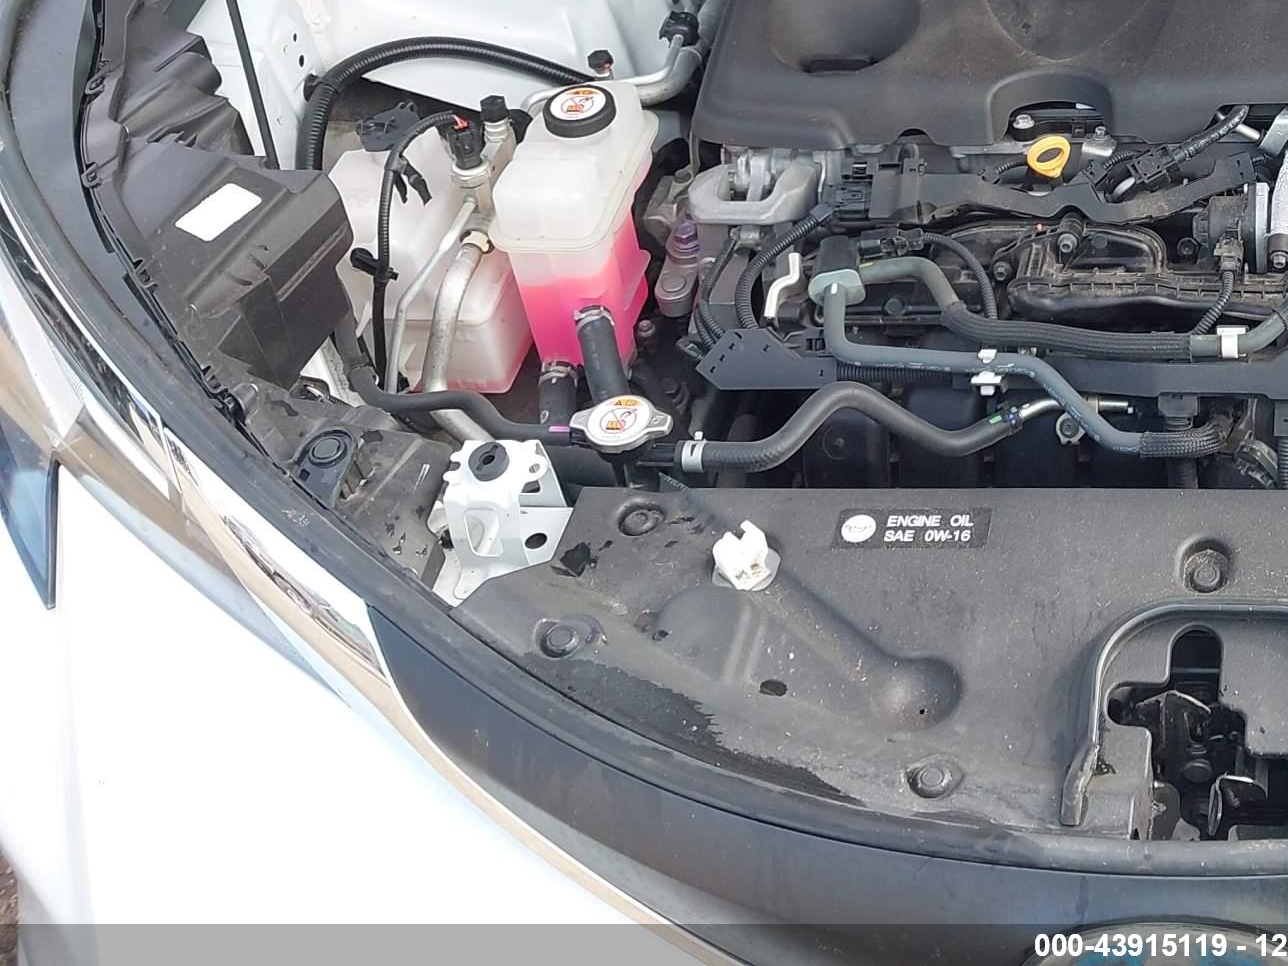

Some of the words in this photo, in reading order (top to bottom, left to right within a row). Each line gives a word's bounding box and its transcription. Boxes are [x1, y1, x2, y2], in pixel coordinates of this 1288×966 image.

[886, 515, 942, 527] ENGINE
[949, 514, 974, 527] OIL
[883, 530, 915, 542] SAE
[924, 530, 971, 542] 0W-16
